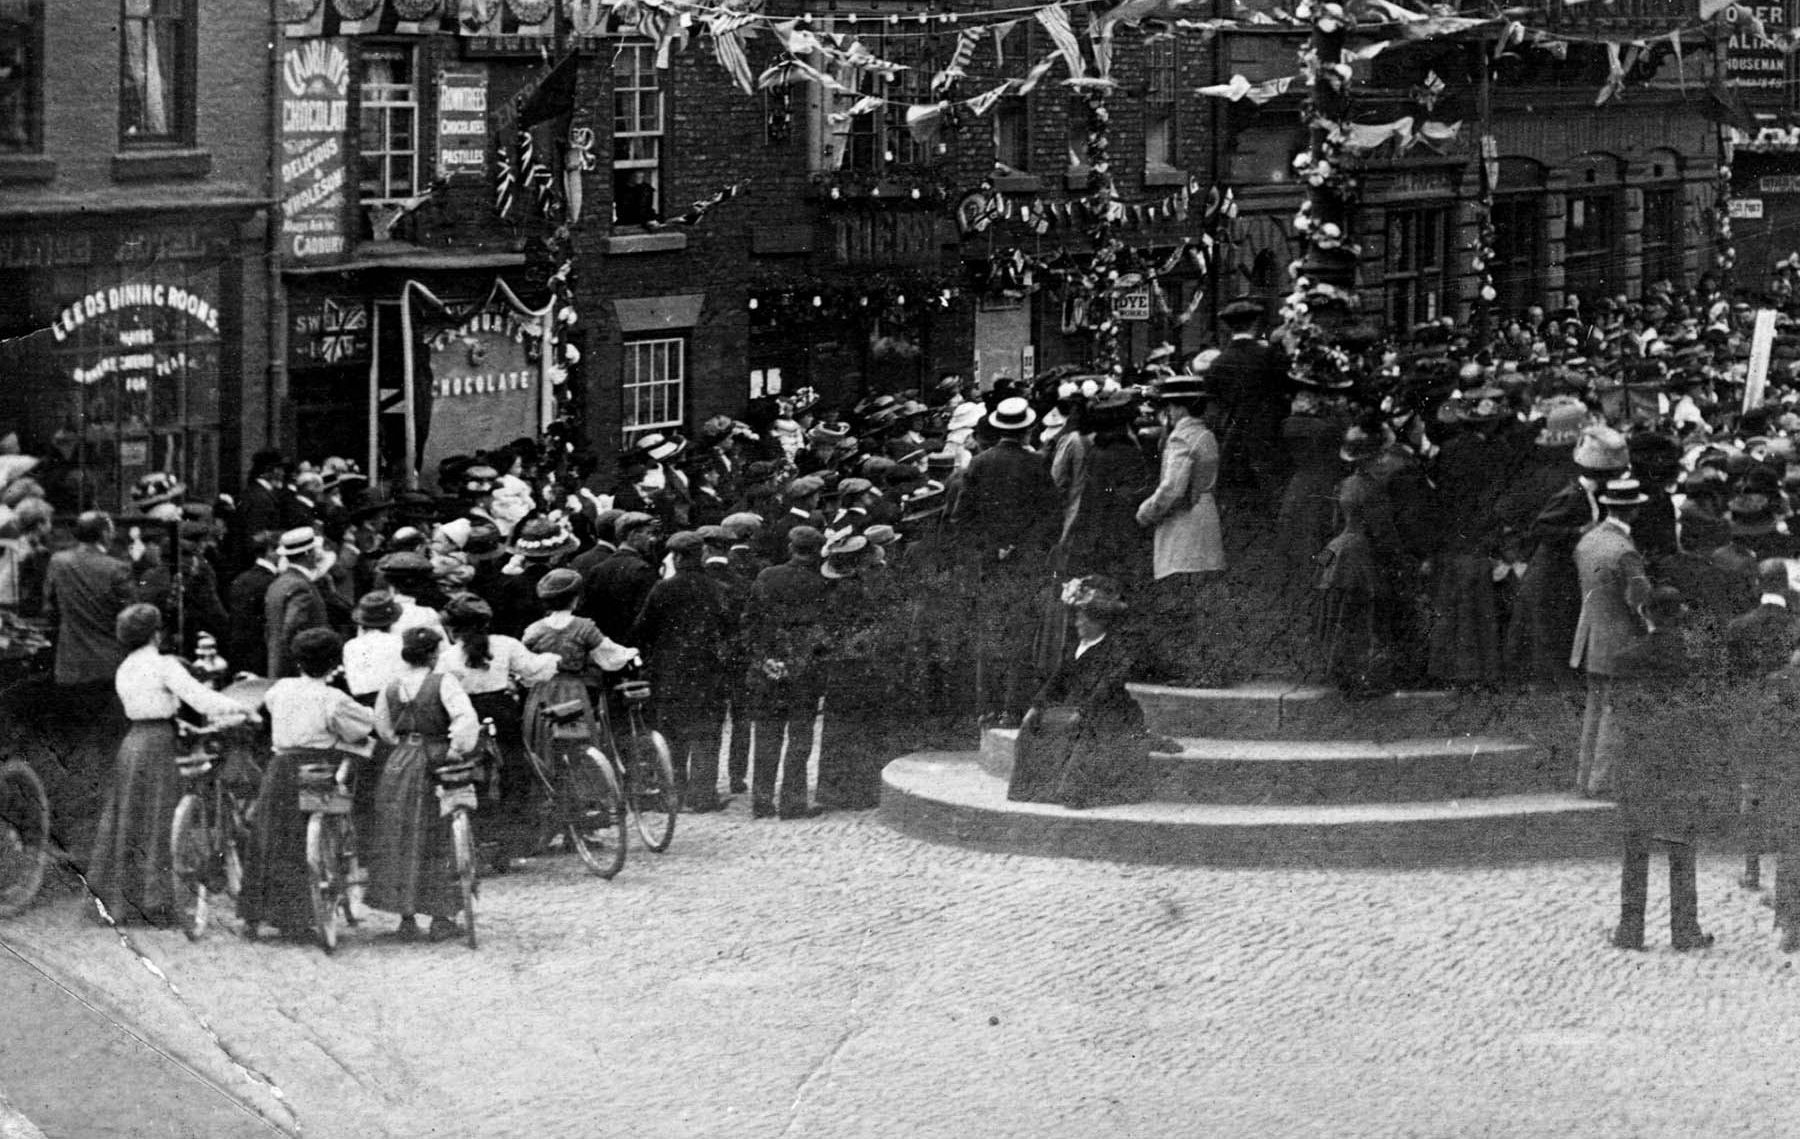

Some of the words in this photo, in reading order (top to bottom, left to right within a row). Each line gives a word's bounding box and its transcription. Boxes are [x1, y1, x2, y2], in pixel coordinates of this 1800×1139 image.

[1726, 59, 1784, 71] HOUSEMAN
[441, 149, 485, 164] PASTILLES
[53, 290, 107, 342] LEEDS
[109, 283, 165, 311] DINING
[431, 370, 529, 398] CHOCOLATE
